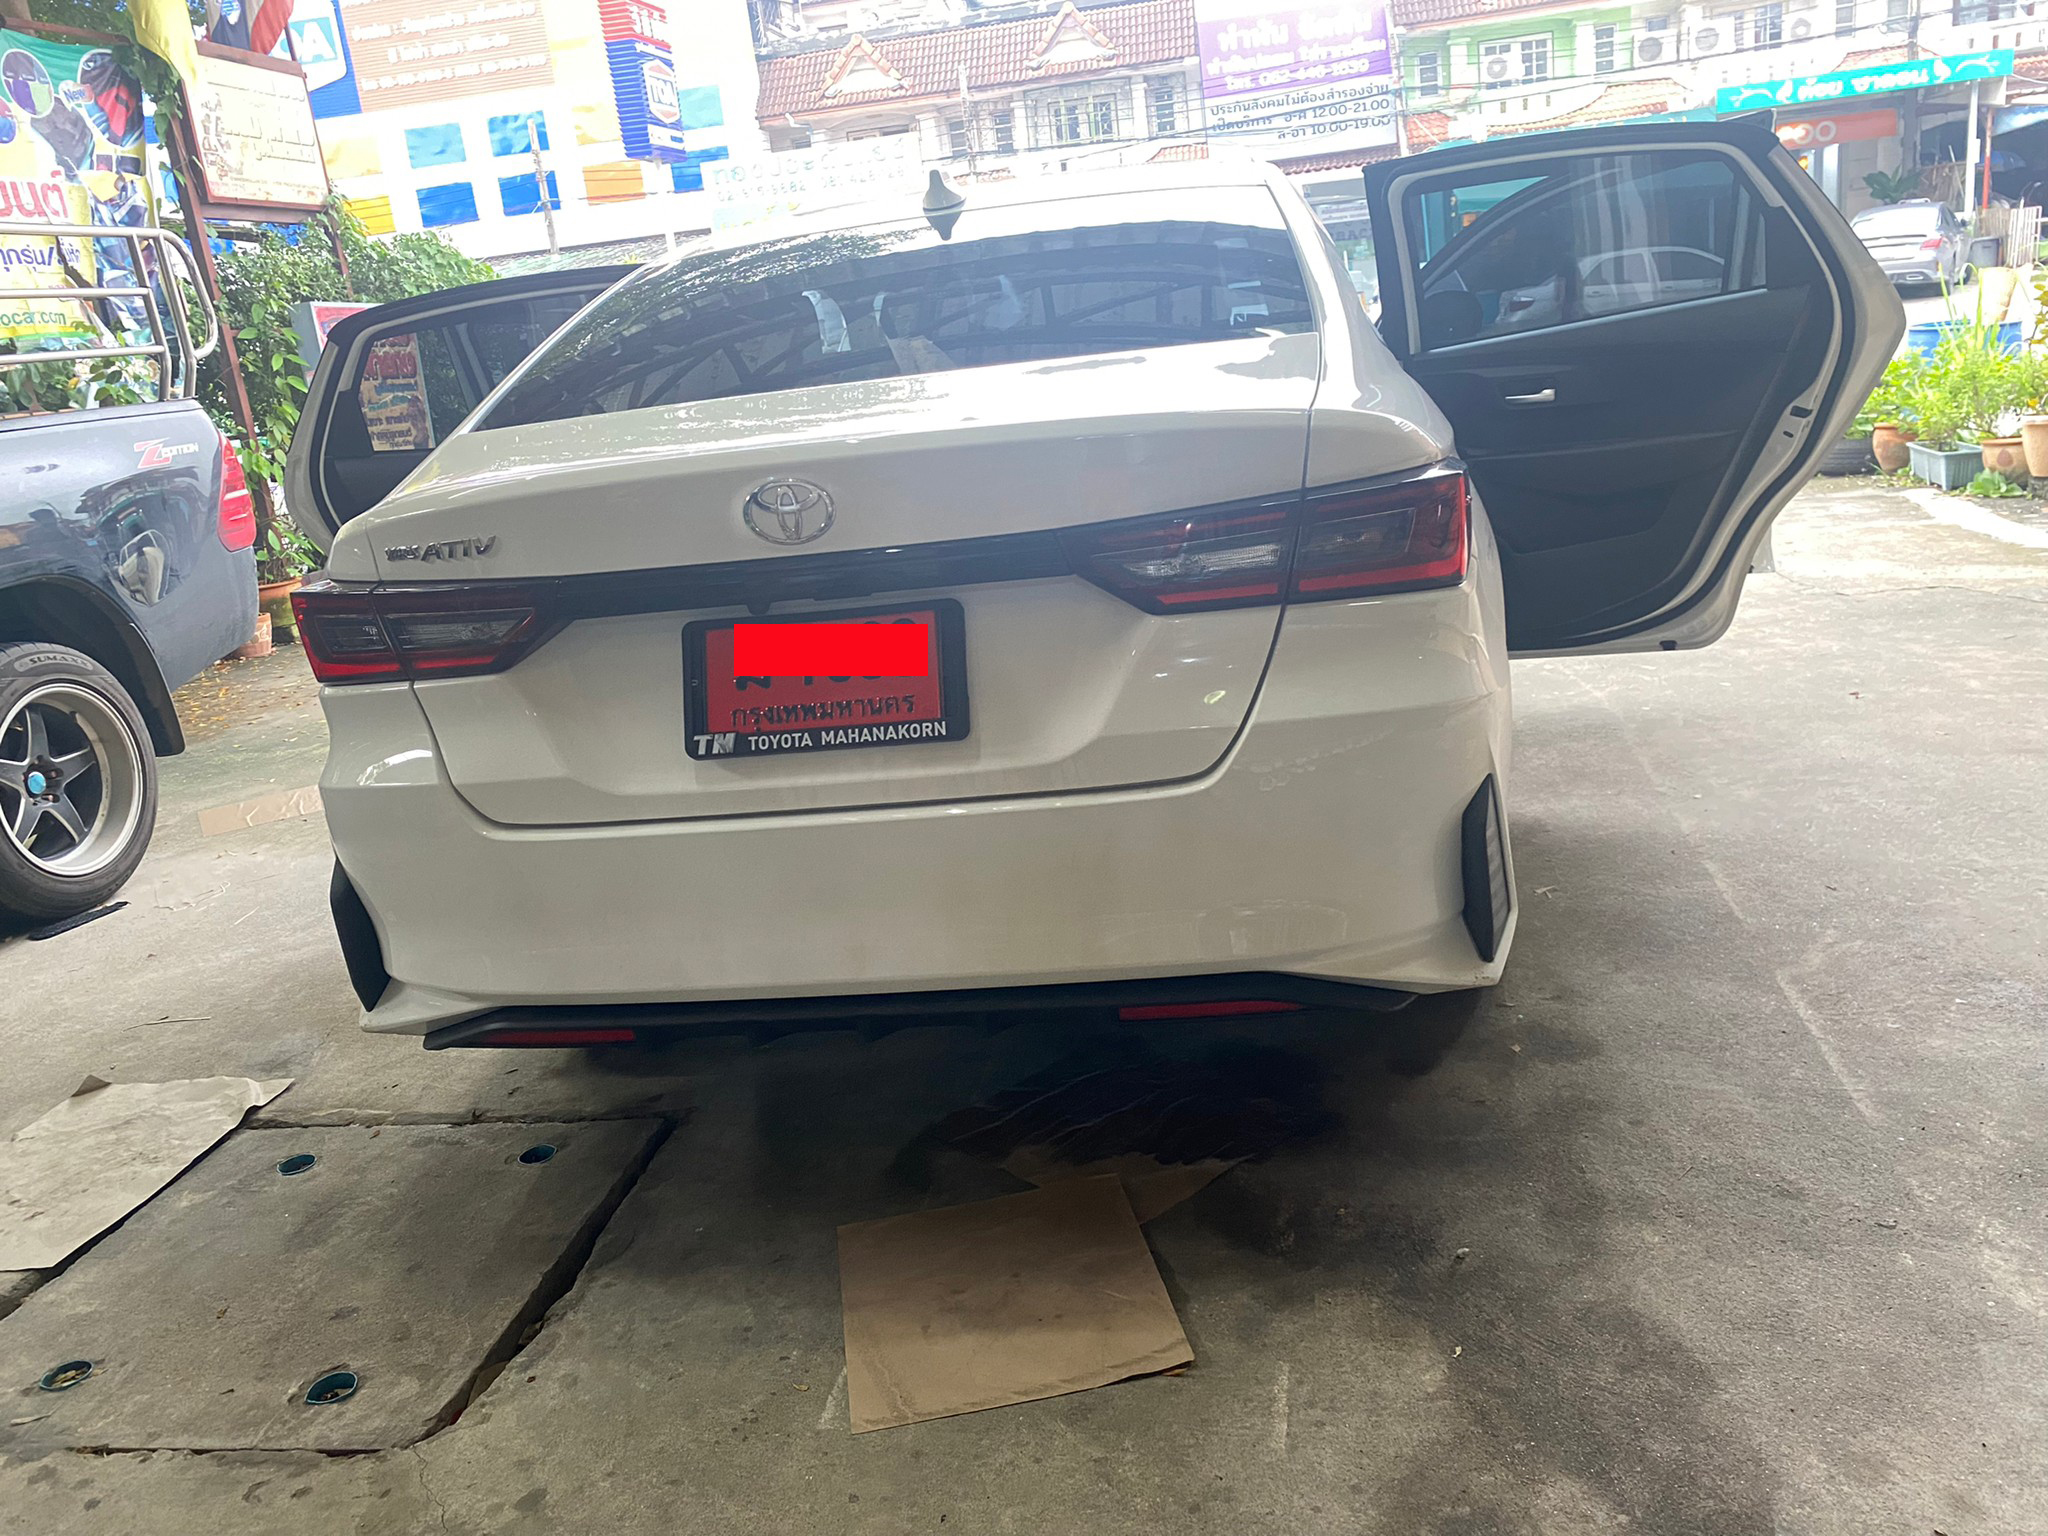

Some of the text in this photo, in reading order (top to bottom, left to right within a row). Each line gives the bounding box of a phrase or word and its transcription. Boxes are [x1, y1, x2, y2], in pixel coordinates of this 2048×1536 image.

[421, 535, 497, 562] ATIV
[731, 694, 915, 732] กรุงเทพมหานคร
[748, 732, 813, 751] TOYOTA
[821, 721, 947, 746] MAHANAKORN
